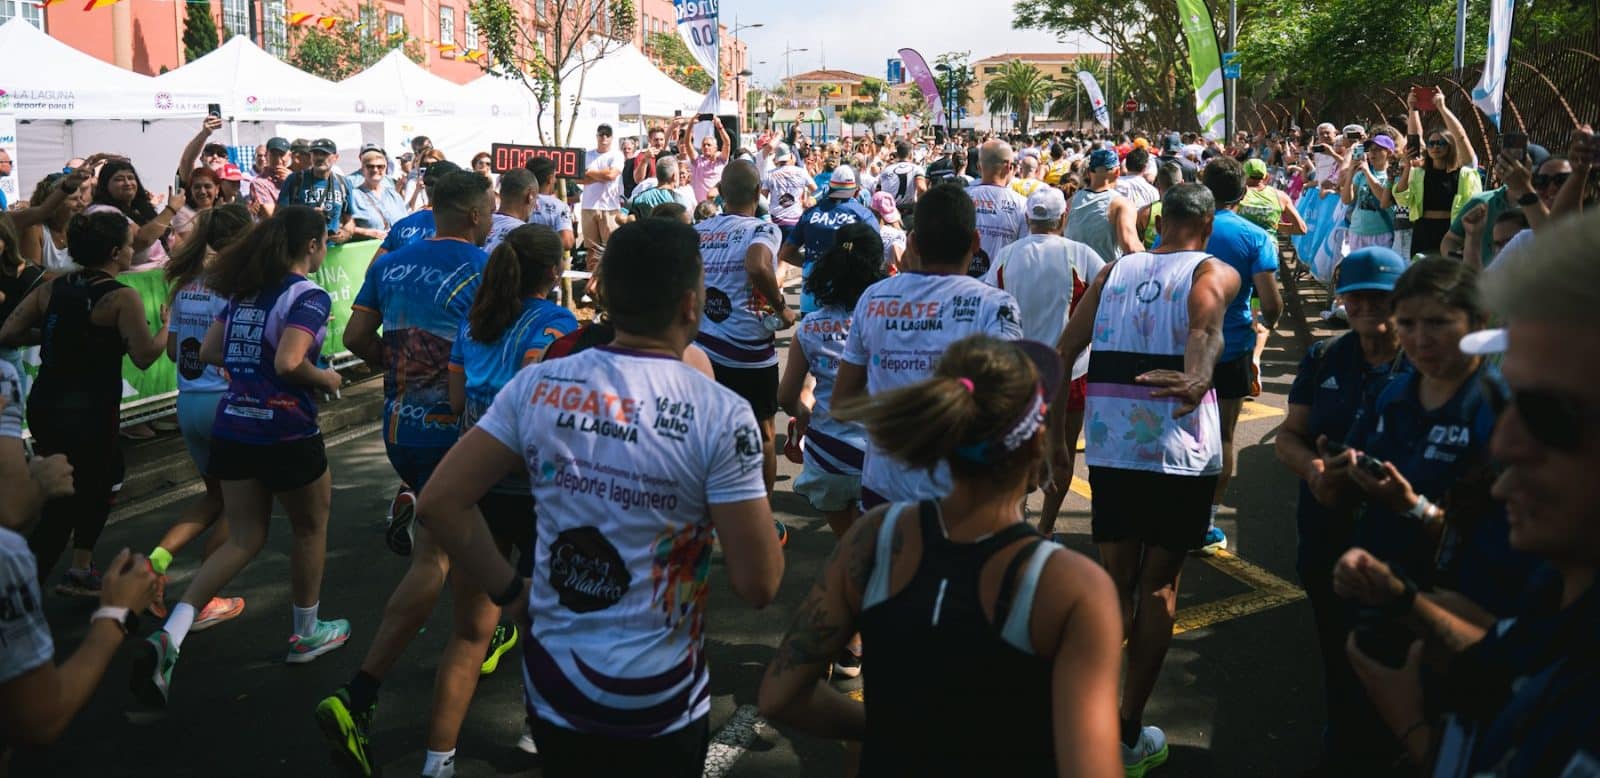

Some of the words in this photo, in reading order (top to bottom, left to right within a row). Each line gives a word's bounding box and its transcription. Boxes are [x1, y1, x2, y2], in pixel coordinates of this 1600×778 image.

[14, 90, 28, 99] LA
[31, 90, 75, 99] LAGUNA
[14, 101, 46, 110] deporte
[809, 211, 857, 226] BAJOS
[382, 263, 417, 282] VOY
[866, 300, 939, 319] FAGATE
[952, 307, 976, 319] julio
[886, 319, 897, 331] LA
[901, 319, 943, 331] LAGUNA
[880, 356, 926, 373] deporte
[530, 381, 636, 425] FAGATE
[656, 396, 669, 412] 16
[670, 401, 682, 415] al
[556, 412, 576, 430] LA
[580, 417, 638, 443] LAGUNA
[653, 414, 689, 434] julio
[555, 465, 607, 499] deporte
[608, 478, 679, 511] lagunero
